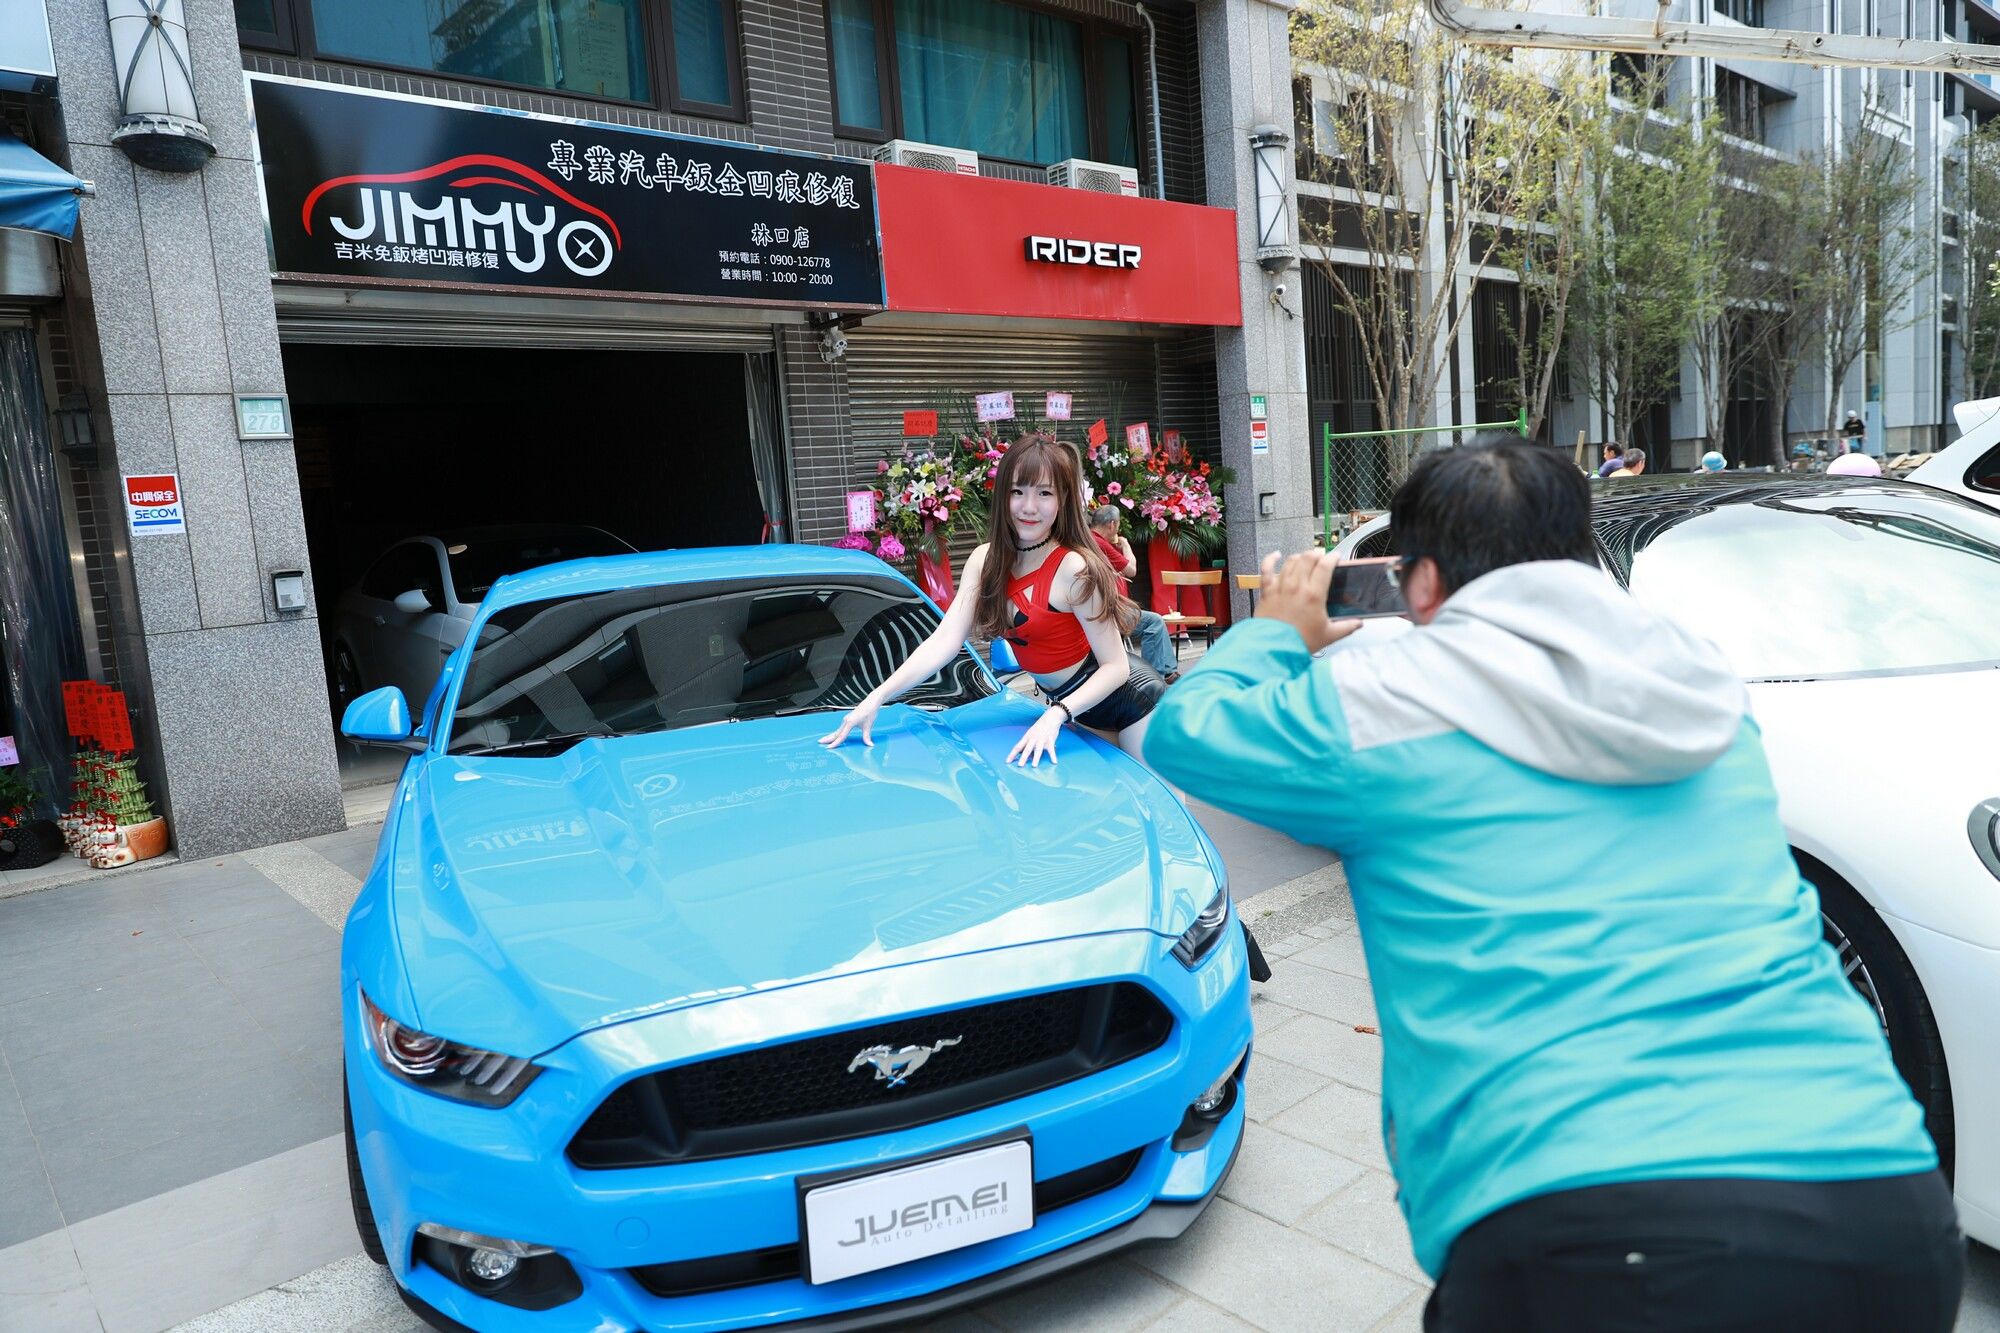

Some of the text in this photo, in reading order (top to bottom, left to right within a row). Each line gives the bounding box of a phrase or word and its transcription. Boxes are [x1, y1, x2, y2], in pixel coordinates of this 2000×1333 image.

[547, 139, 861, 209] 專業汽車鈑金凹痕修復
[751, 223, 811, 249] 林口店
[334, 241, 500, 269] 吉米免鈑烤凹痕修復
[769, 254, 831, 269] 0900-126778
[1026, 235, 1142, 269] RIDER
[134, 508, 178, 520] SECOM
[837, 1181, 1009, 1248] JUEMEI
[871, 1203, 1009, 1248] Auto Detailing
